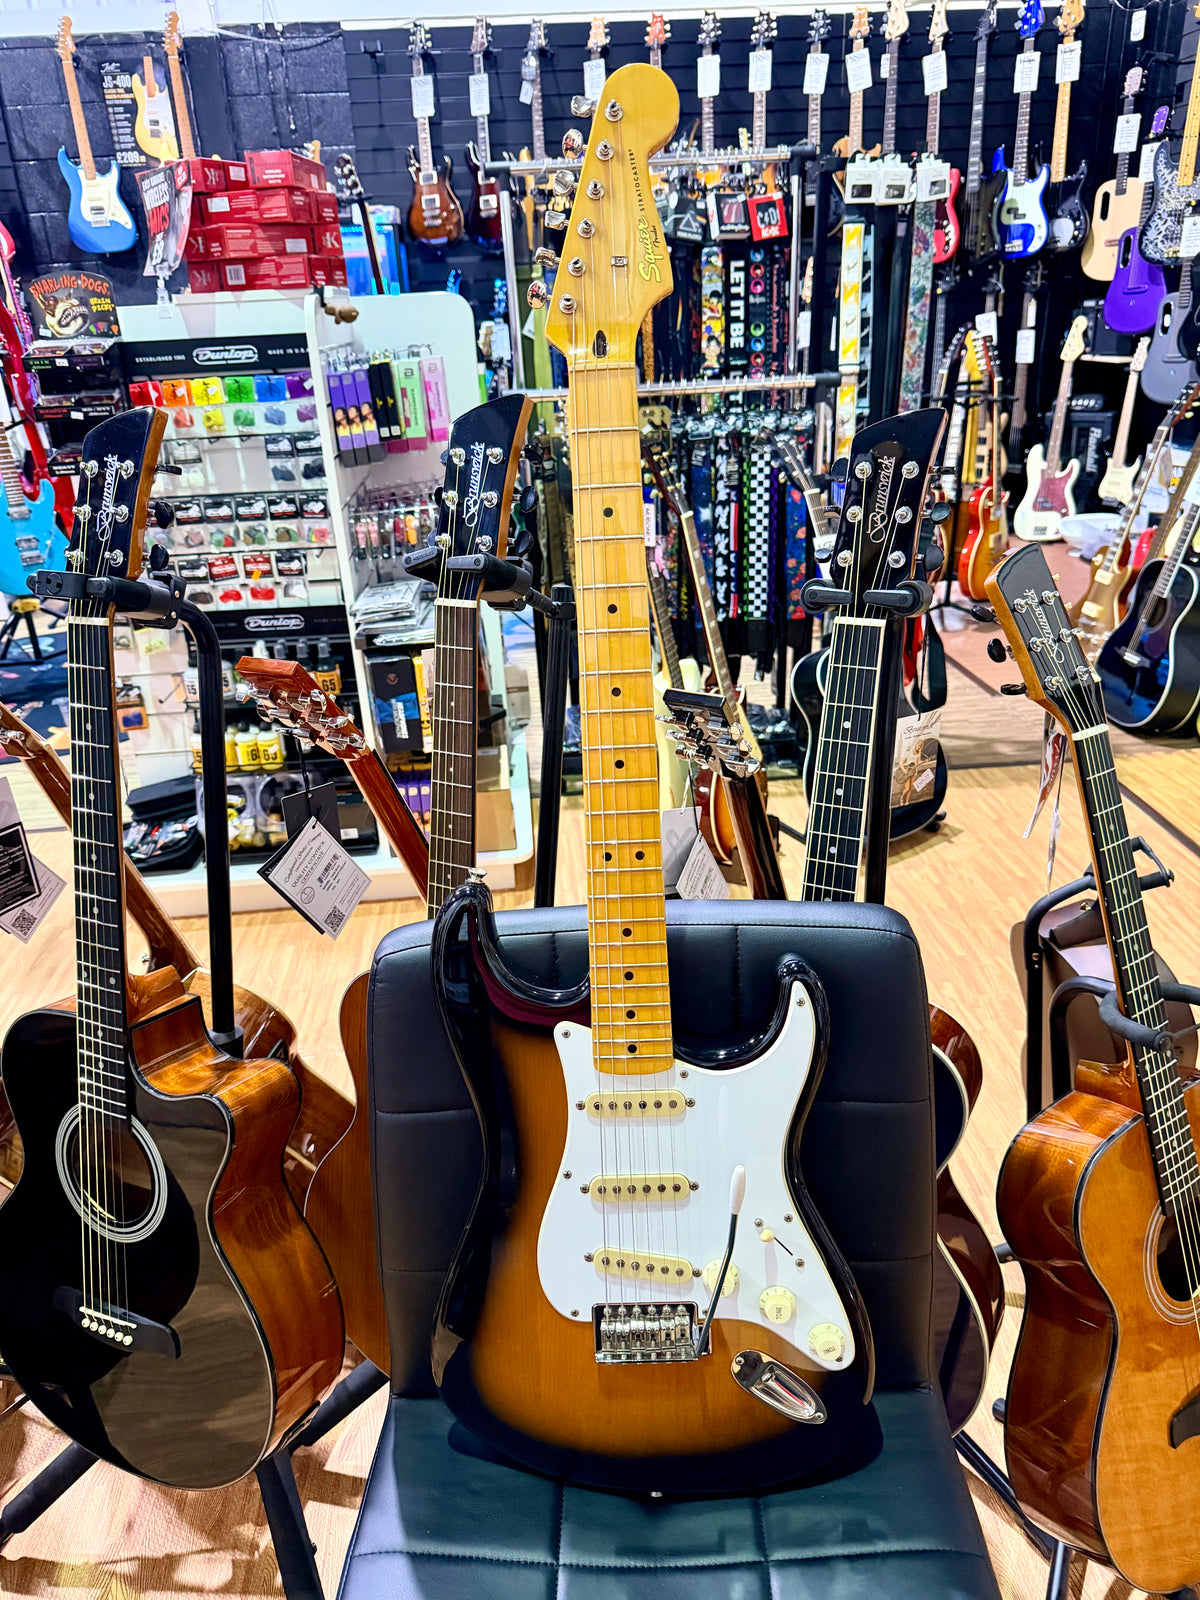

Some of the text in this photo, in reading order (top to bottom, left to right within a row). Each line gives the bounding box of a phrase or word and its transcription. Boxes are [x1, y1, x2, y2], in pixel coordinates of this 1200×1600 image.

[103, 75, 132, 88] JS-400
[116, 151, 140, 163] £209
[629, 151, 645, 212] STRATOCASTER
[149, 202, 169, 236] MICS
[638, 215, 664, 283] Squier
[29, 273, 110, 298] SNARLING DOGS
[730, 260, 745, 298] LET
[730, 300, 745, 321] IT
[730, 322, 745, 349] BE
[197, 348, 257, 361] Dunlop
[1085, 426, 1103, 474] Randall
[96, 453, 118, 541] Brunswick
[462, 441, 485, 527] Brunswick
[866, 455, 896, 543] Brunswick
[248, 616, 303, 628] Dunlop
[322, 679, 336, 692] 65
[291, 840, 326, 888] QUALITY CONTROL
[300, 851, 325, 885] CERTIFICATE
